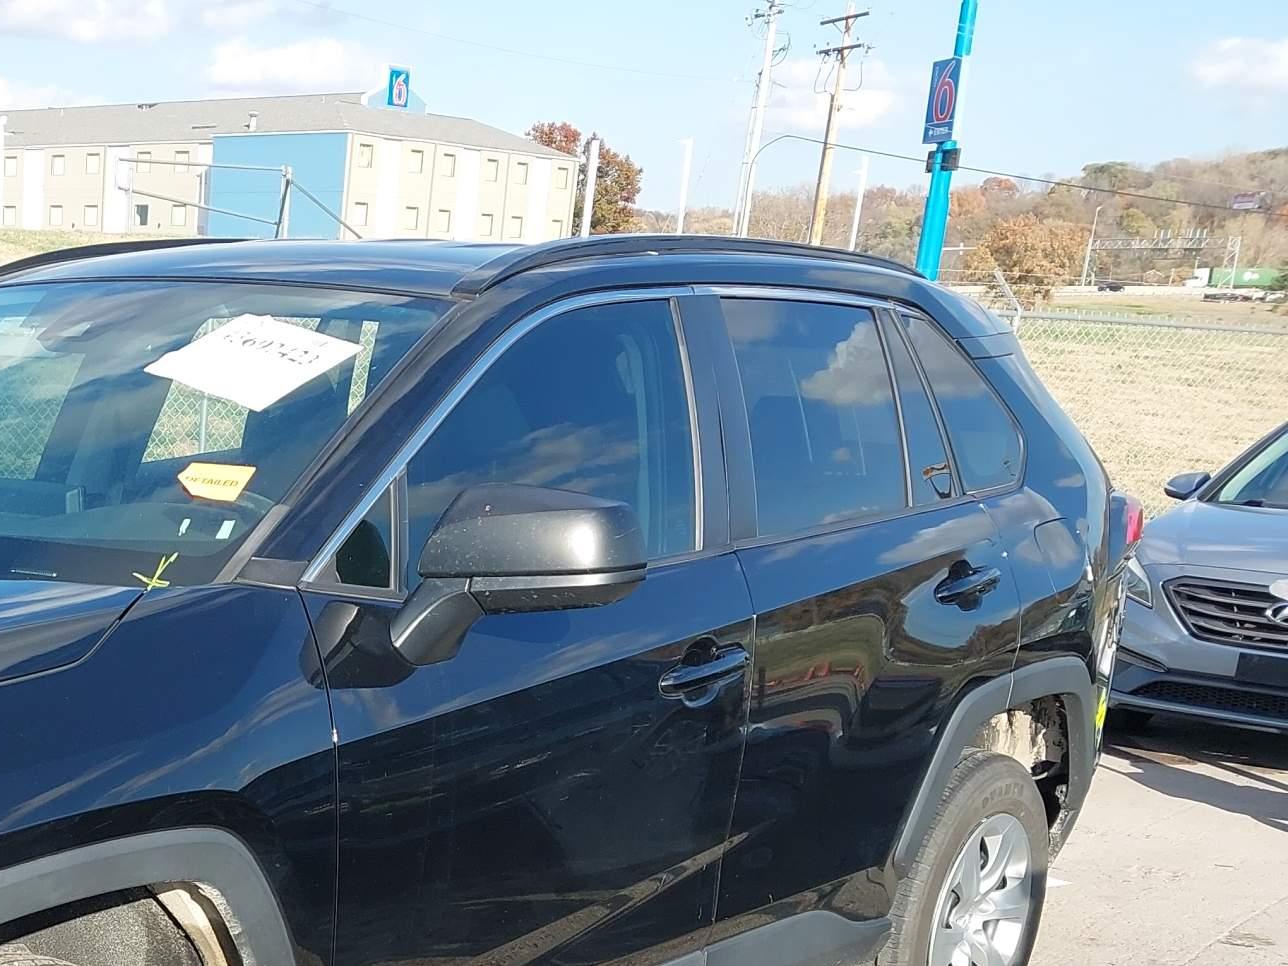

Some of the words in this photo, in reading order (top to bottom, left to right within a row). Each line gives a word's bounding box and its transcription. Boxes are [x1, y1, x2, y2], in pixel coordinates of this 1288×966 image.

[393, 73, 408, 107] 6
[932, 59, 956, 123] 6
[185, 475, 239, 488] DETAILED
